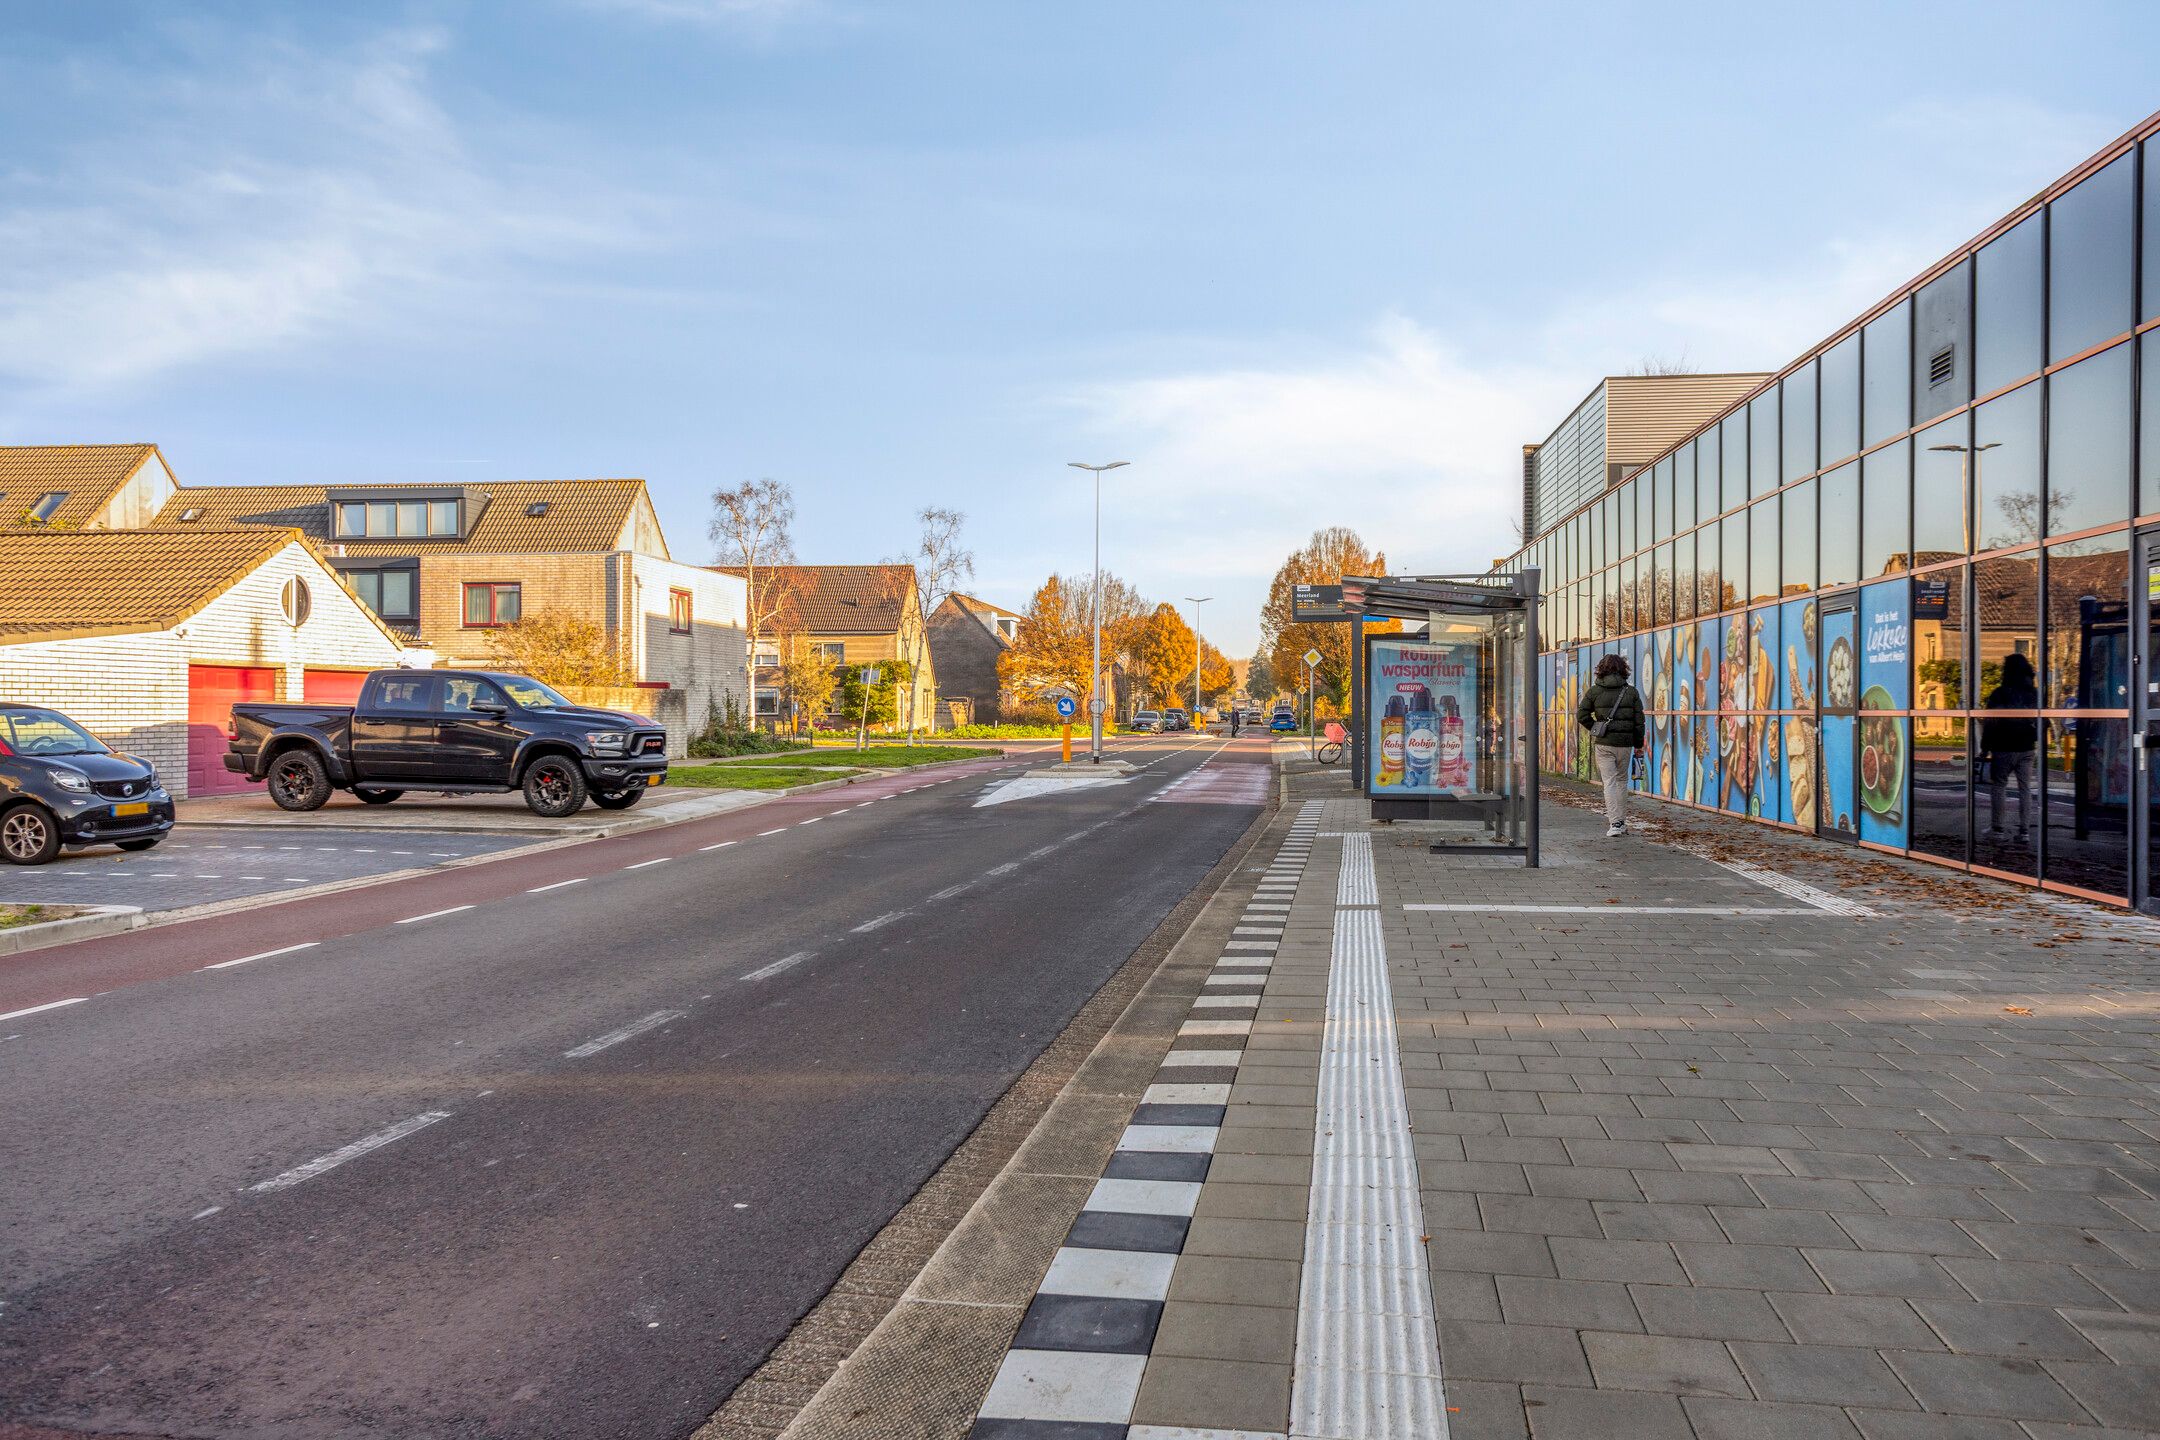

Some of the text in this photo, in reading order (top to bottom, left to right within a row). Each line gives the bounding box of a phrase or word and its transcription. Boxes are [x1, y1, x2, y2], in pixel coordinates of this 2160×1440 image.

[1400, 644, 1447, 663] Robijn
[1869, 654, 1879, 663] van
[1879, 651, 1892, 662] Albert
[1382, 663, 1465, 679] wasparfum
[1399, 683, 1423, 691] NIEUW
[1408, 738, 1436, 749] Robijn
[1441, 740, 1460, 749] obijn
